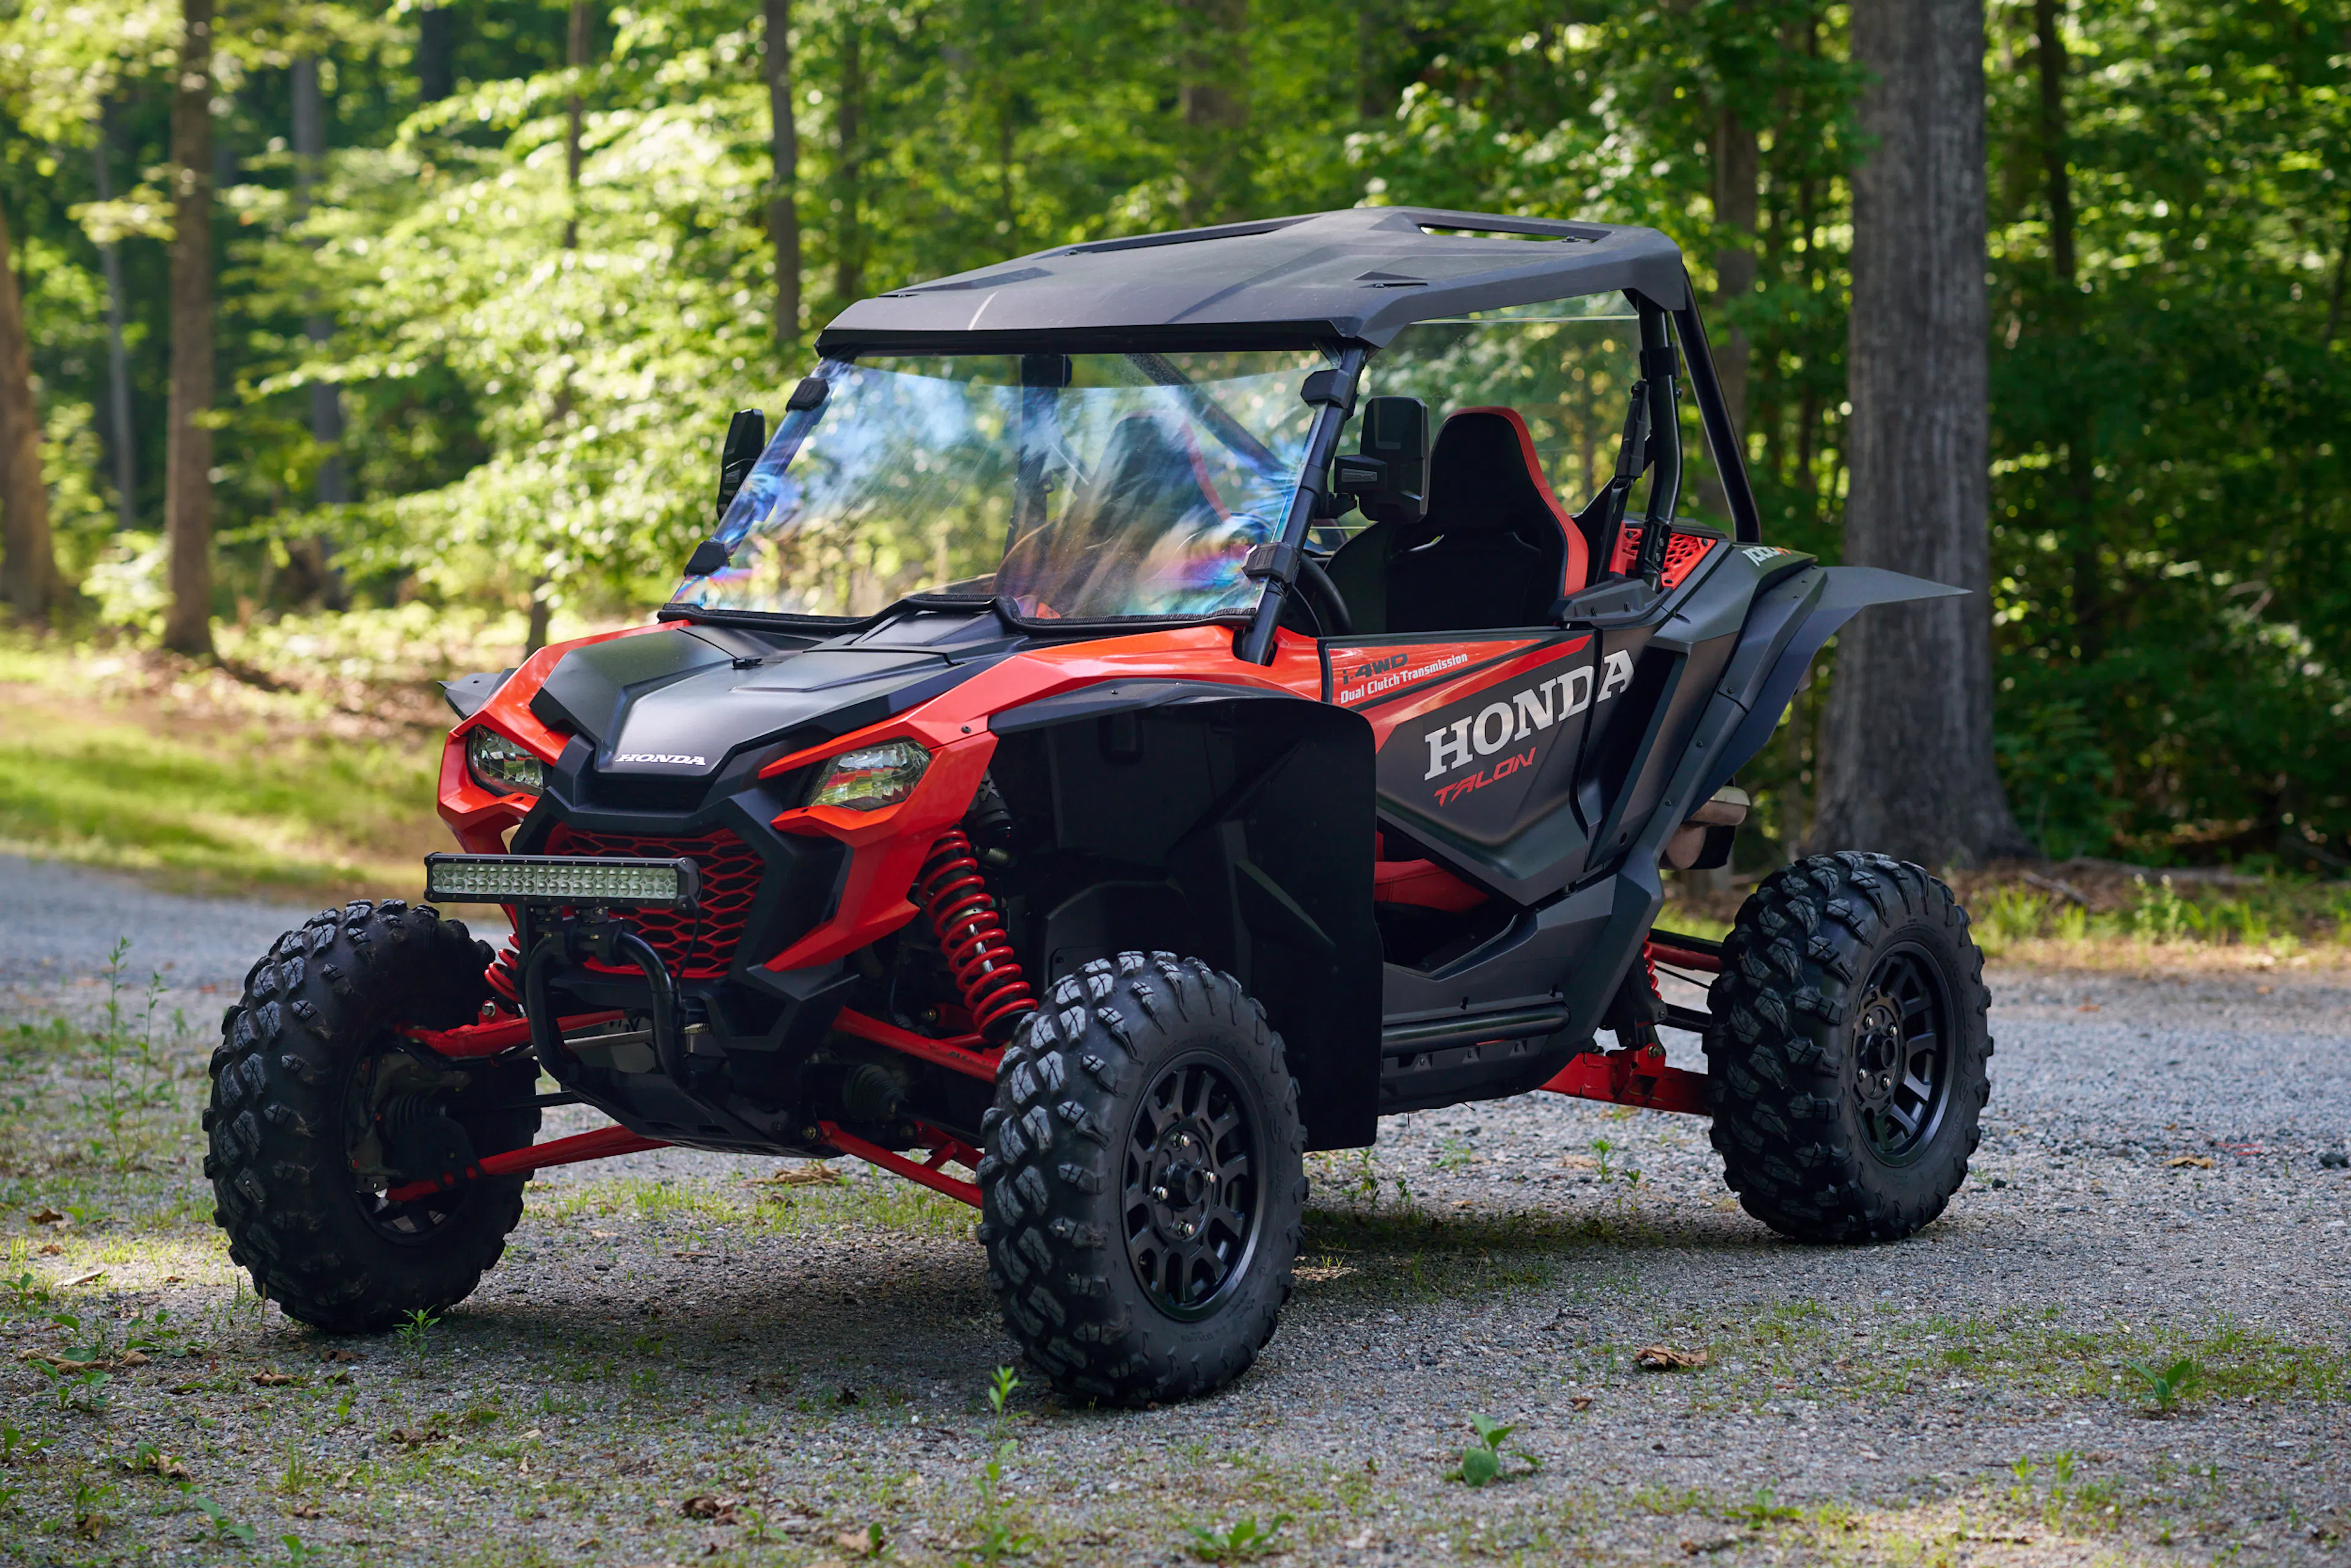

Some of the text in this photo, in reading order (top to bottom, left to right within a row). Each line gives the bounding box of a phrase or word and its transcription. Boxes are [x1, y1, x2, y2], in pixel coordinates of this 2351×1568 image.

[1340, 653, 1468, 704] Dual Clutch Transmission
[1343, 653, 1408, 685] i-4WD
[1424, 649, 1635, 781] HONDA
[615, 754, 707, 766] HONDA
[1433, 746, 1537, 807] TALON
